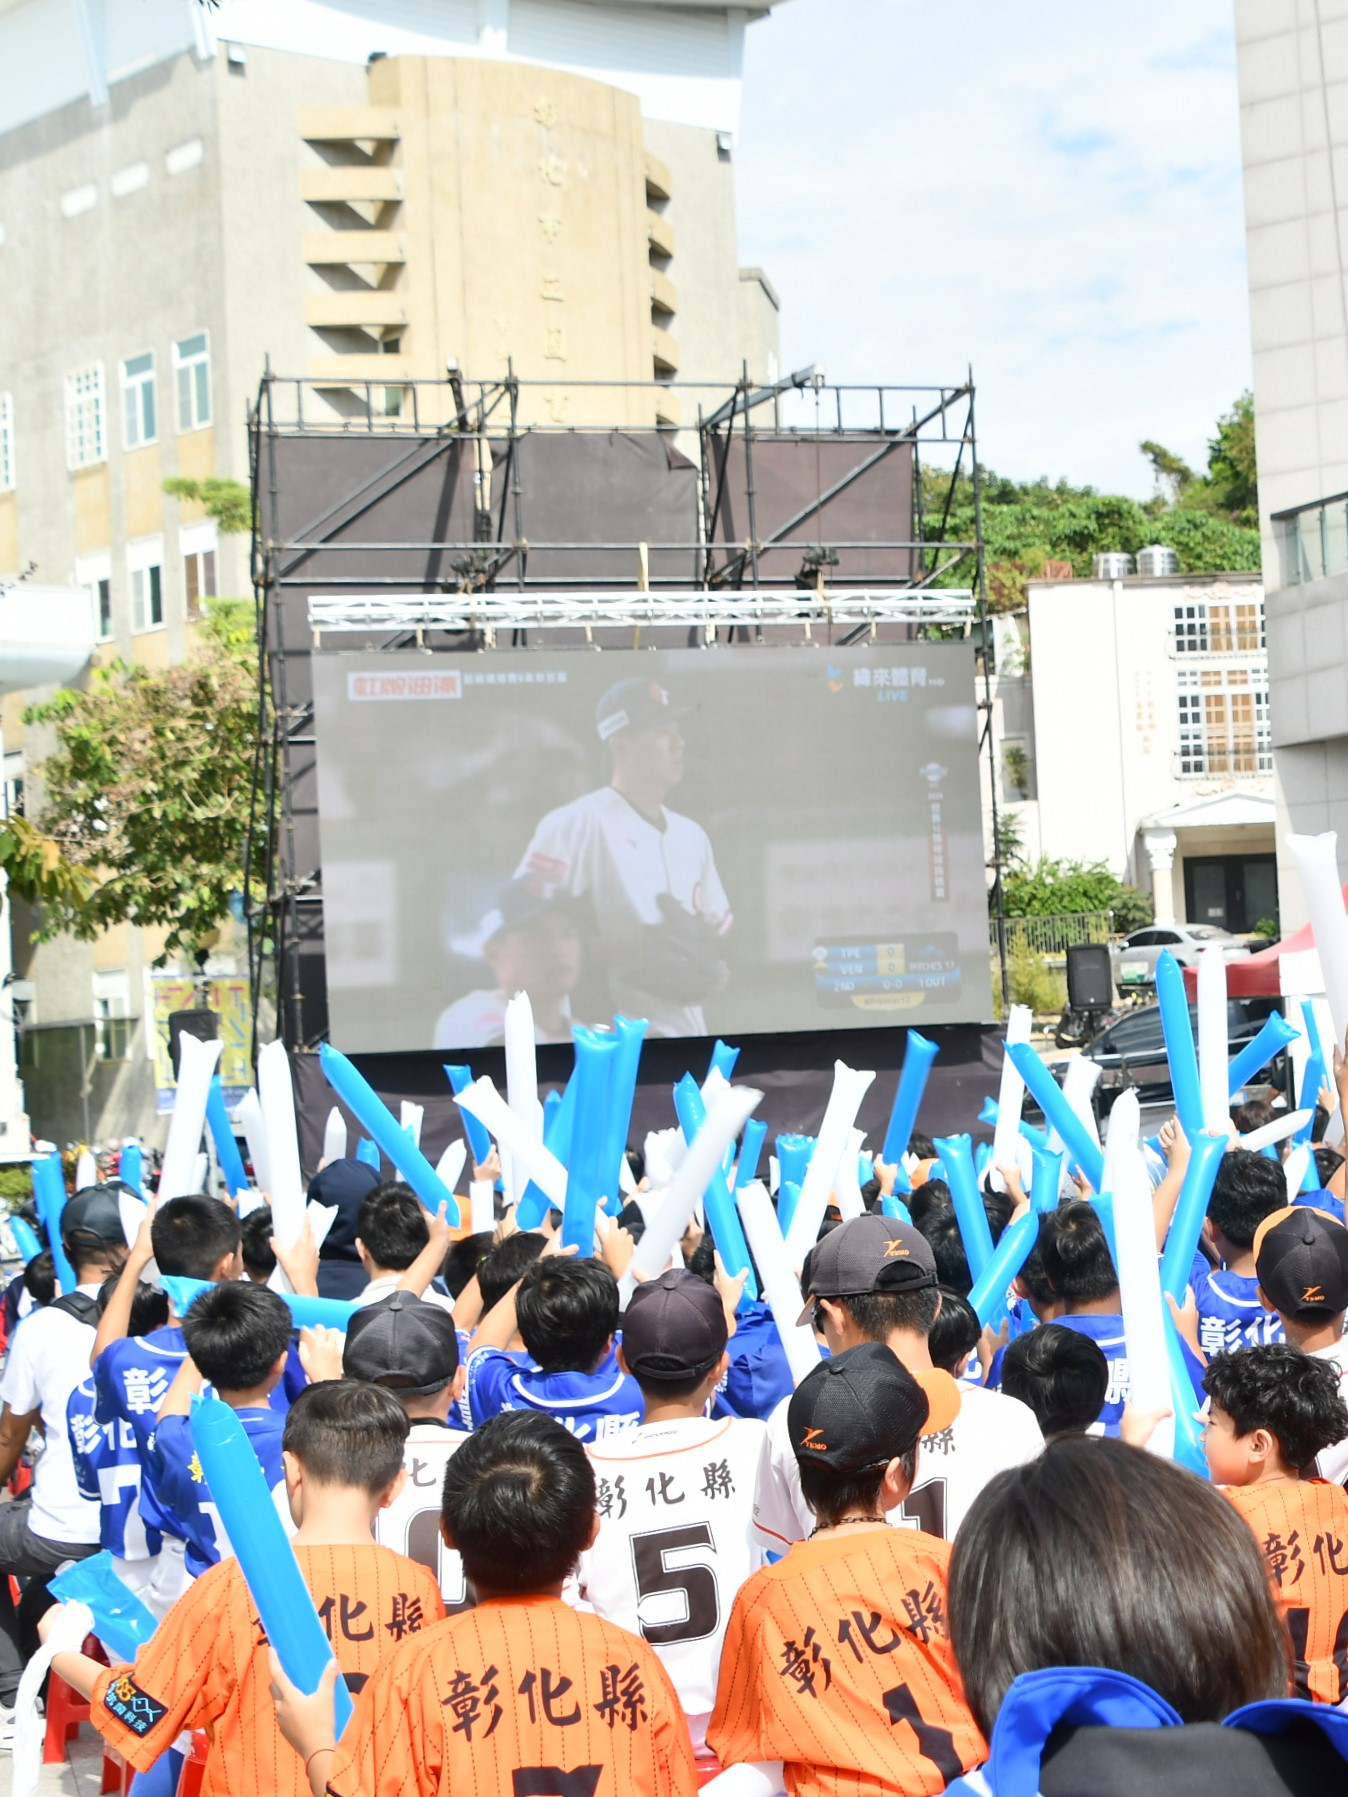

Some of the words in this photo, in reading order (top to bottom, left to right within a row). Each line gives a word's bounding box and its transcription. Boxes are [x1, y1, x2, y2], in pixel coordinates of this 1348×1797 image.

[596, 1457, 736, 1521] 彰化縣
[629, 1520, 721, 1647] 5
[780, 1580, 949, 1699] 彰化縣
[441, 1661, 649, 1743] 彰化縣
